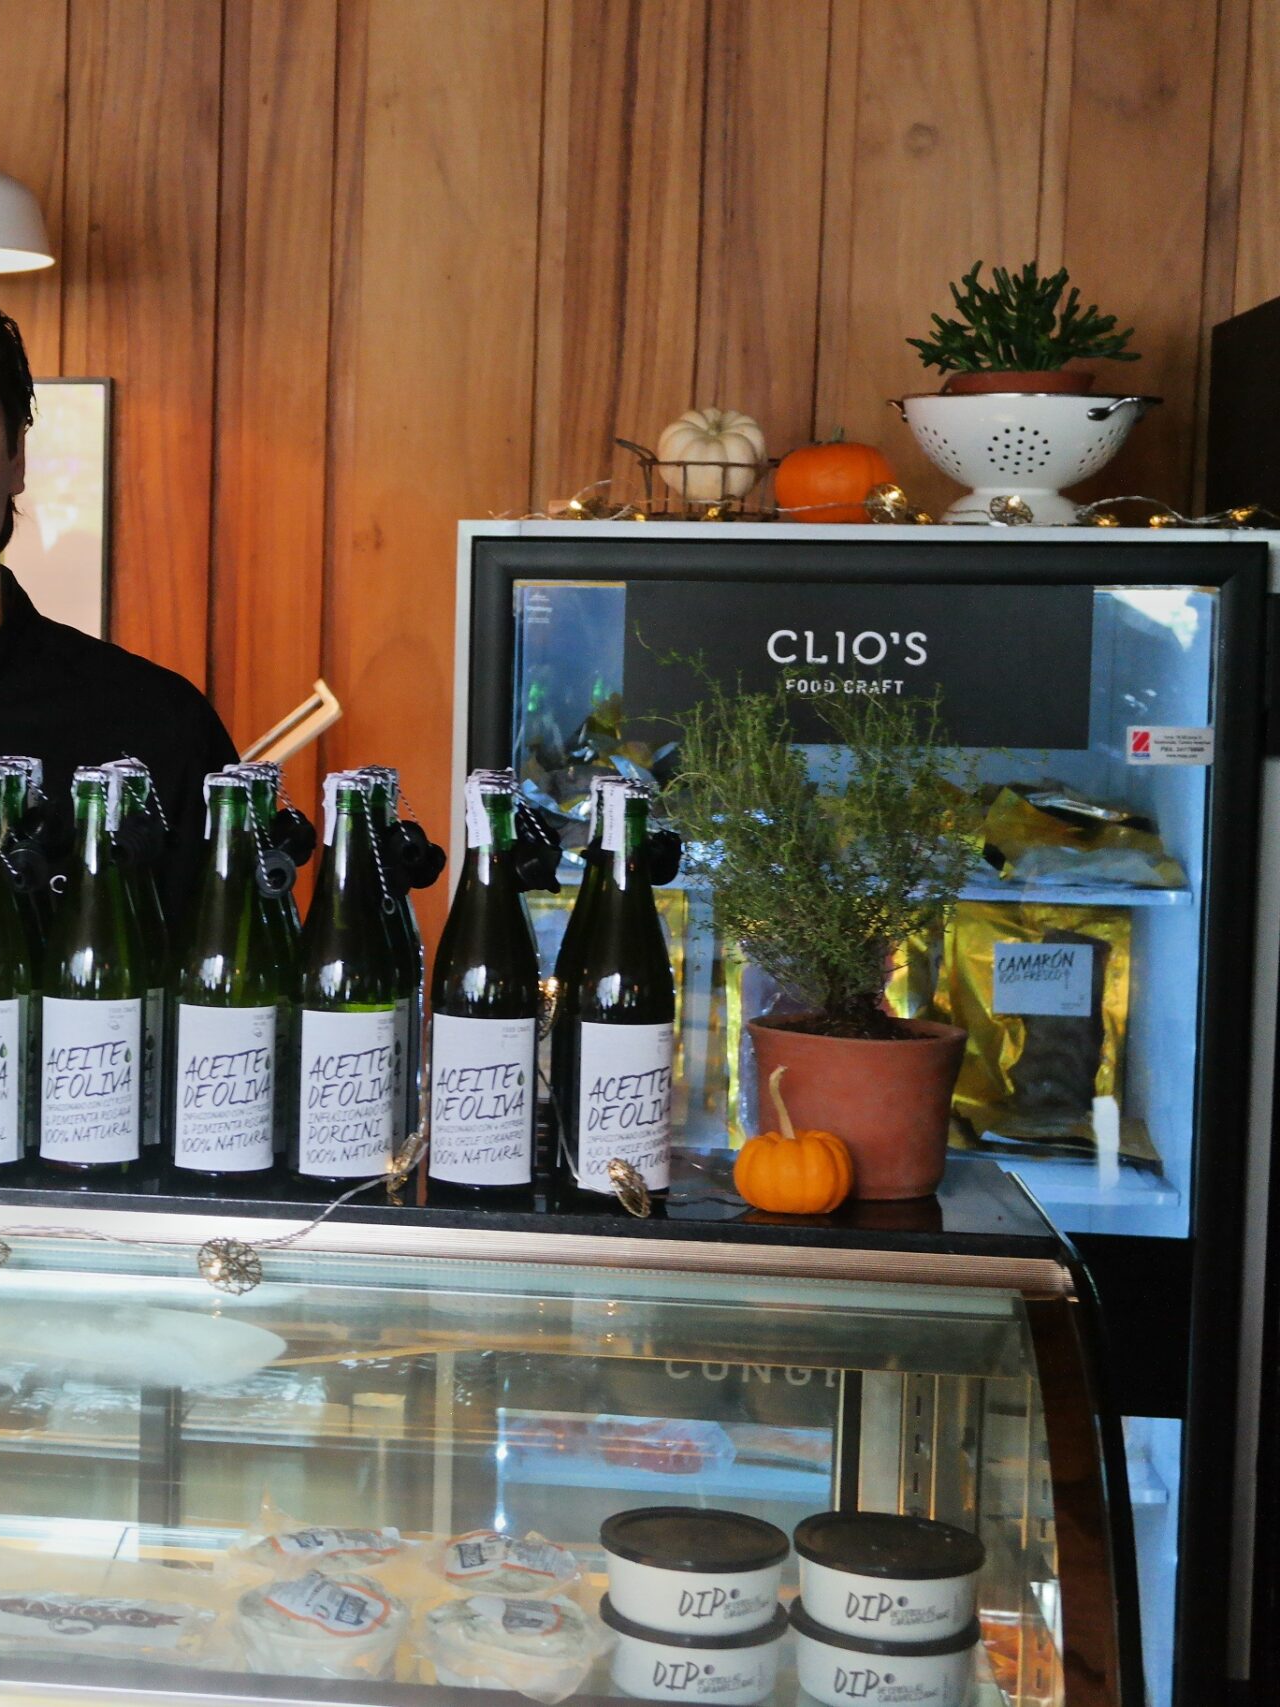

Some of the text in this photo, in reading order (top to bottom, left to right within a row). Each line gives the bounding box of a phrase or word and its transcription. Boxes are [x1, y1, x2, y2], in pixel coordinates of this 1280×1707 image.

[766, 629, 928, 666] CLIO'S
[785, 679, 904, 695] FOOD CRAFT
[998, 948, 1075, 972] CAMARÓN
[46, 1040, 127, 1073] ACEITE
[185, 1047, 268, 1081] ACEITE
[308, 1045, 390, 1082] ACEITE
[46, 1076, 69, 1100] DE
[70, 1065, 132, 1098] OLIVA
[184, 1075, 271, 1109] DE OLIVA
[308, 1073, 392, 1109] DE OLIVA
[437, 1063, 520, 1096] ACEITE
[588, 1066, 670, 1104] ACEITE
[435, 1088, 524, 1121] DE OLIVA
[587, 1105, 619, 1131] DE
[72, 1120, 132, 1143] NATURAL
[306, 1118, 383, 1145] PORCINI
[461, 1144, 524, 1165] NATURAL
[586, 1158, 608, 1176] 100
[678, 1587, 726, 1619] DIP
[845, 1591, 893, 1622] DIP
[653, 1661, 700, 1691] DIP
[834, 1667, 880, 1698] DIP
